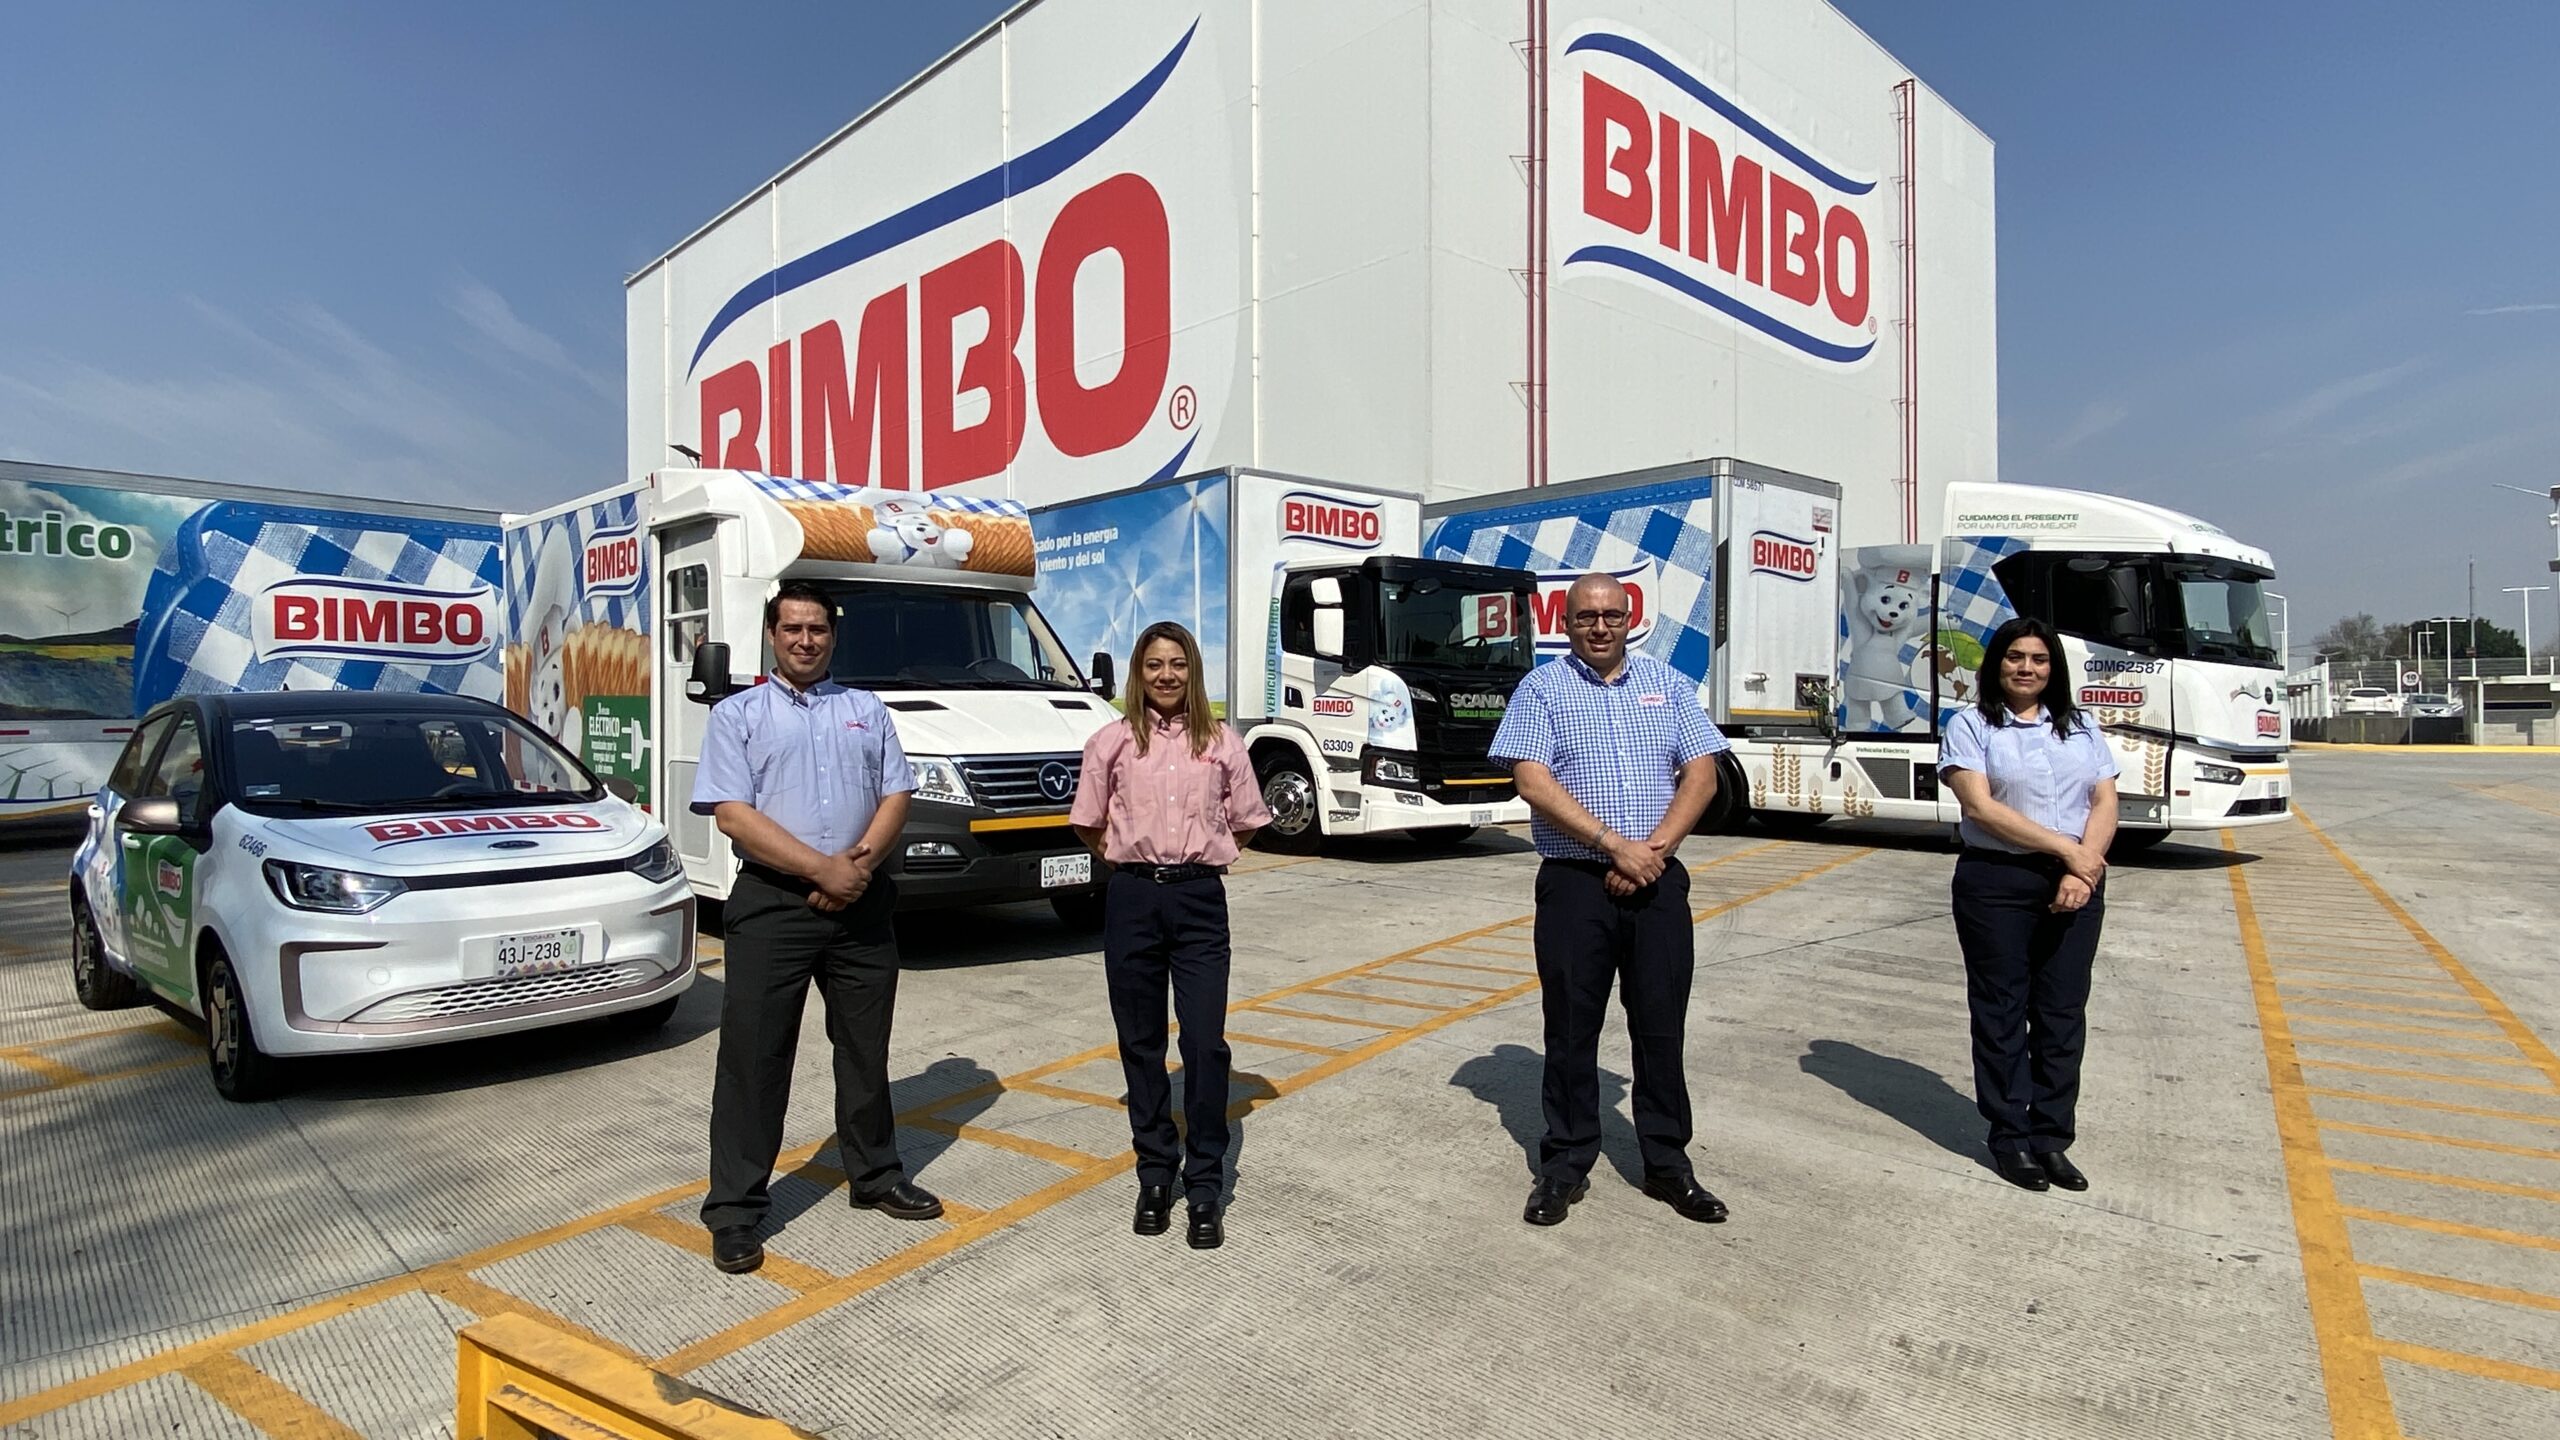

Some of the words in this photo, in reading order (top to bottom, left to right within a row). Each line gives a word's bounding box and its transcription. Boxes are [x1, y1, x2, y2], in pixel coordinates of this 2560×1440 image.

[1582, 69, 1870, 328] BIMBO
[1285, 501, 1379, 541] BIMBO
[1057, 536, 1072, 551] por
[1073, 532, 1082, 546] la
[587, 537, 638, 584] BIMBO
[1040, 557, 1067, 572] viento
[1068, 556, 1074, 570] y
[1075, 551, 1090, 567] del
[1091, 548, 1105, 564] sol
[1753, 539, 1815, 575] BIMBO
[274, 595, 483, 646] BIMBO
[2083, 660, 2165, 674] CDM62587
[1313, 700, 1354, 713] BIMBO
[1449, 693, 1507, 709] SCANIA
[2081, 690, 2144, 704] BIMBO
[1323, 740, 1354, 753] 63309
[365, 813, 603, 842] BIMBO
[498, 942, 561, 965] 43J-238
